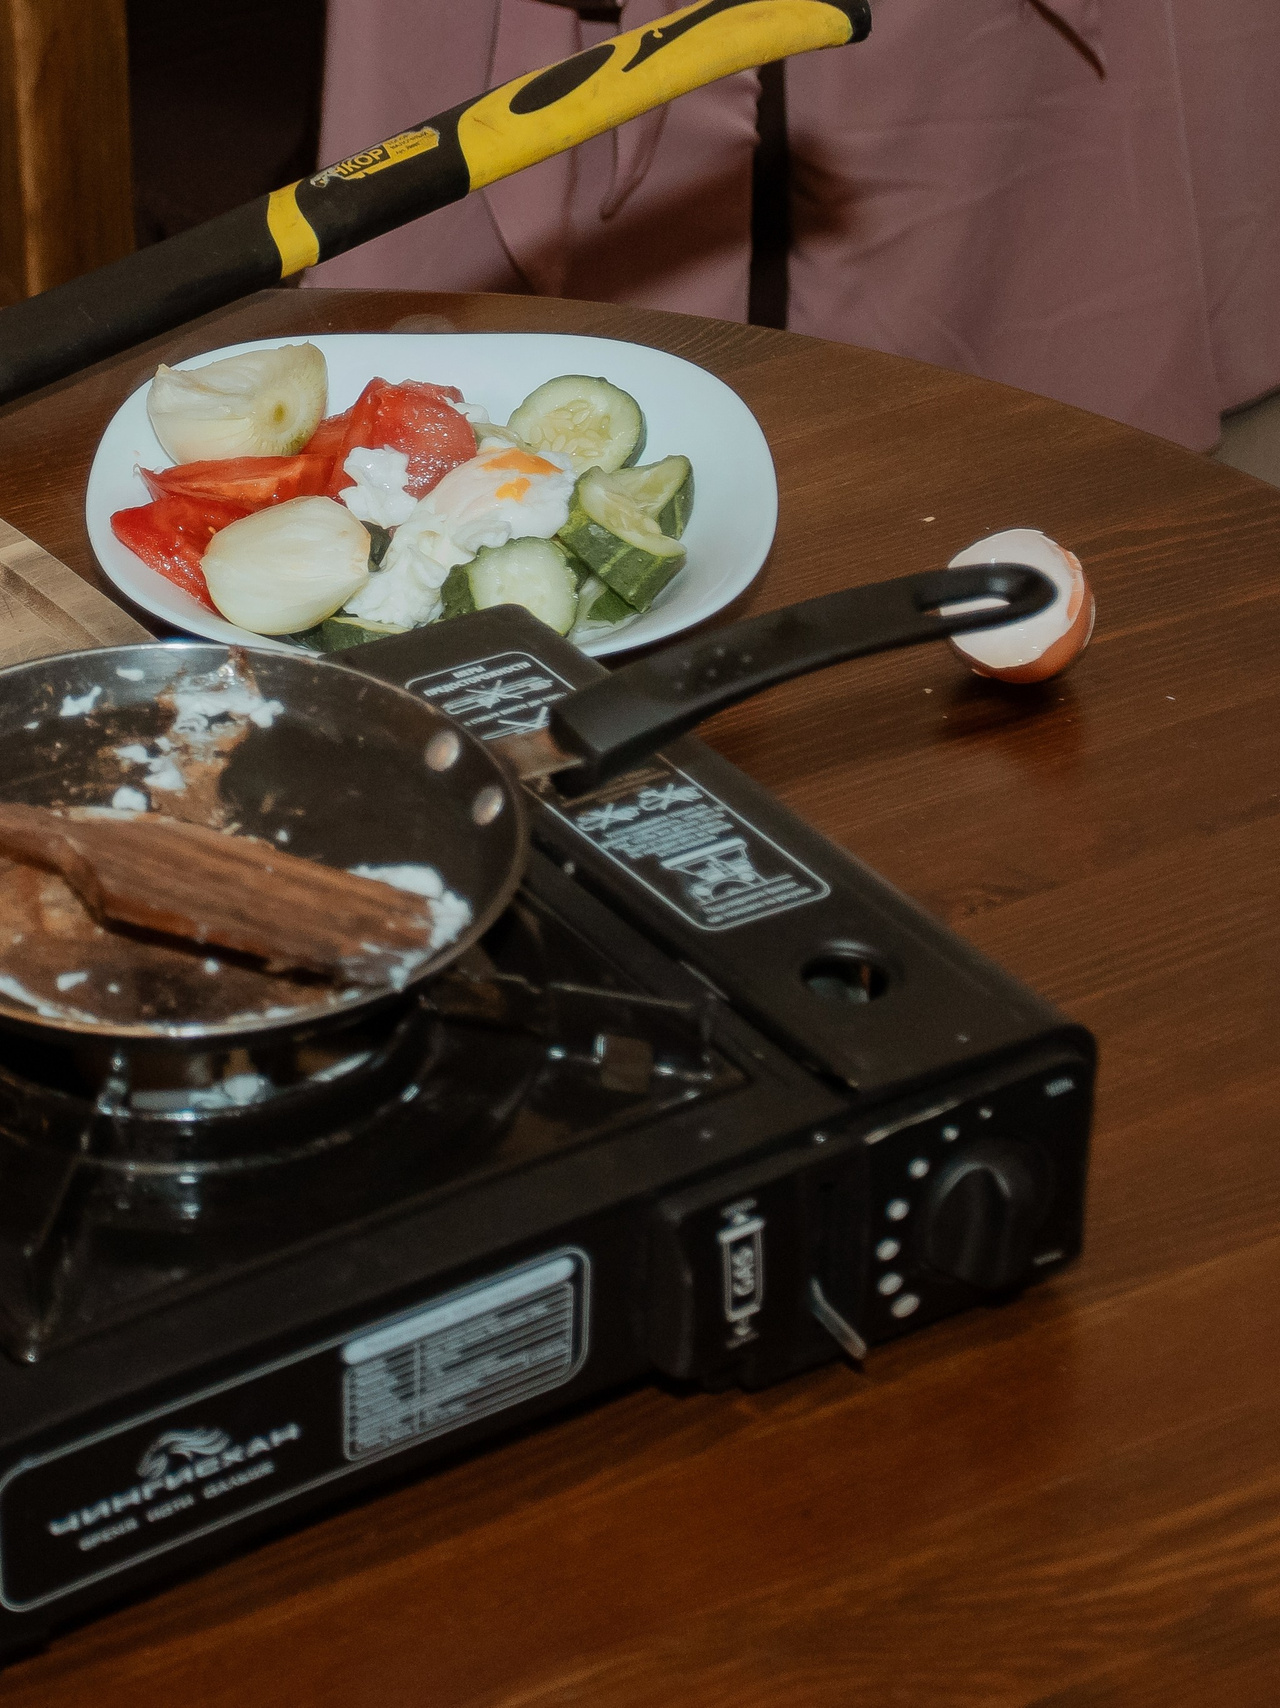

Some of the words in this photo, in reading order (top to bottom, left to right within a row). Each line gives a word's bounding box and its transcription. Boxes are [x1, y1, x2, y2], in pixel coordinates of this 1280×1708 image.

[423, 661, 531, 697] ПРЕДОСТОРОЖНОСТИ
[452, 665, 486, 679] МЕРЫ
[48, 1422, 300, 1536] ЧИНГИСХАН
